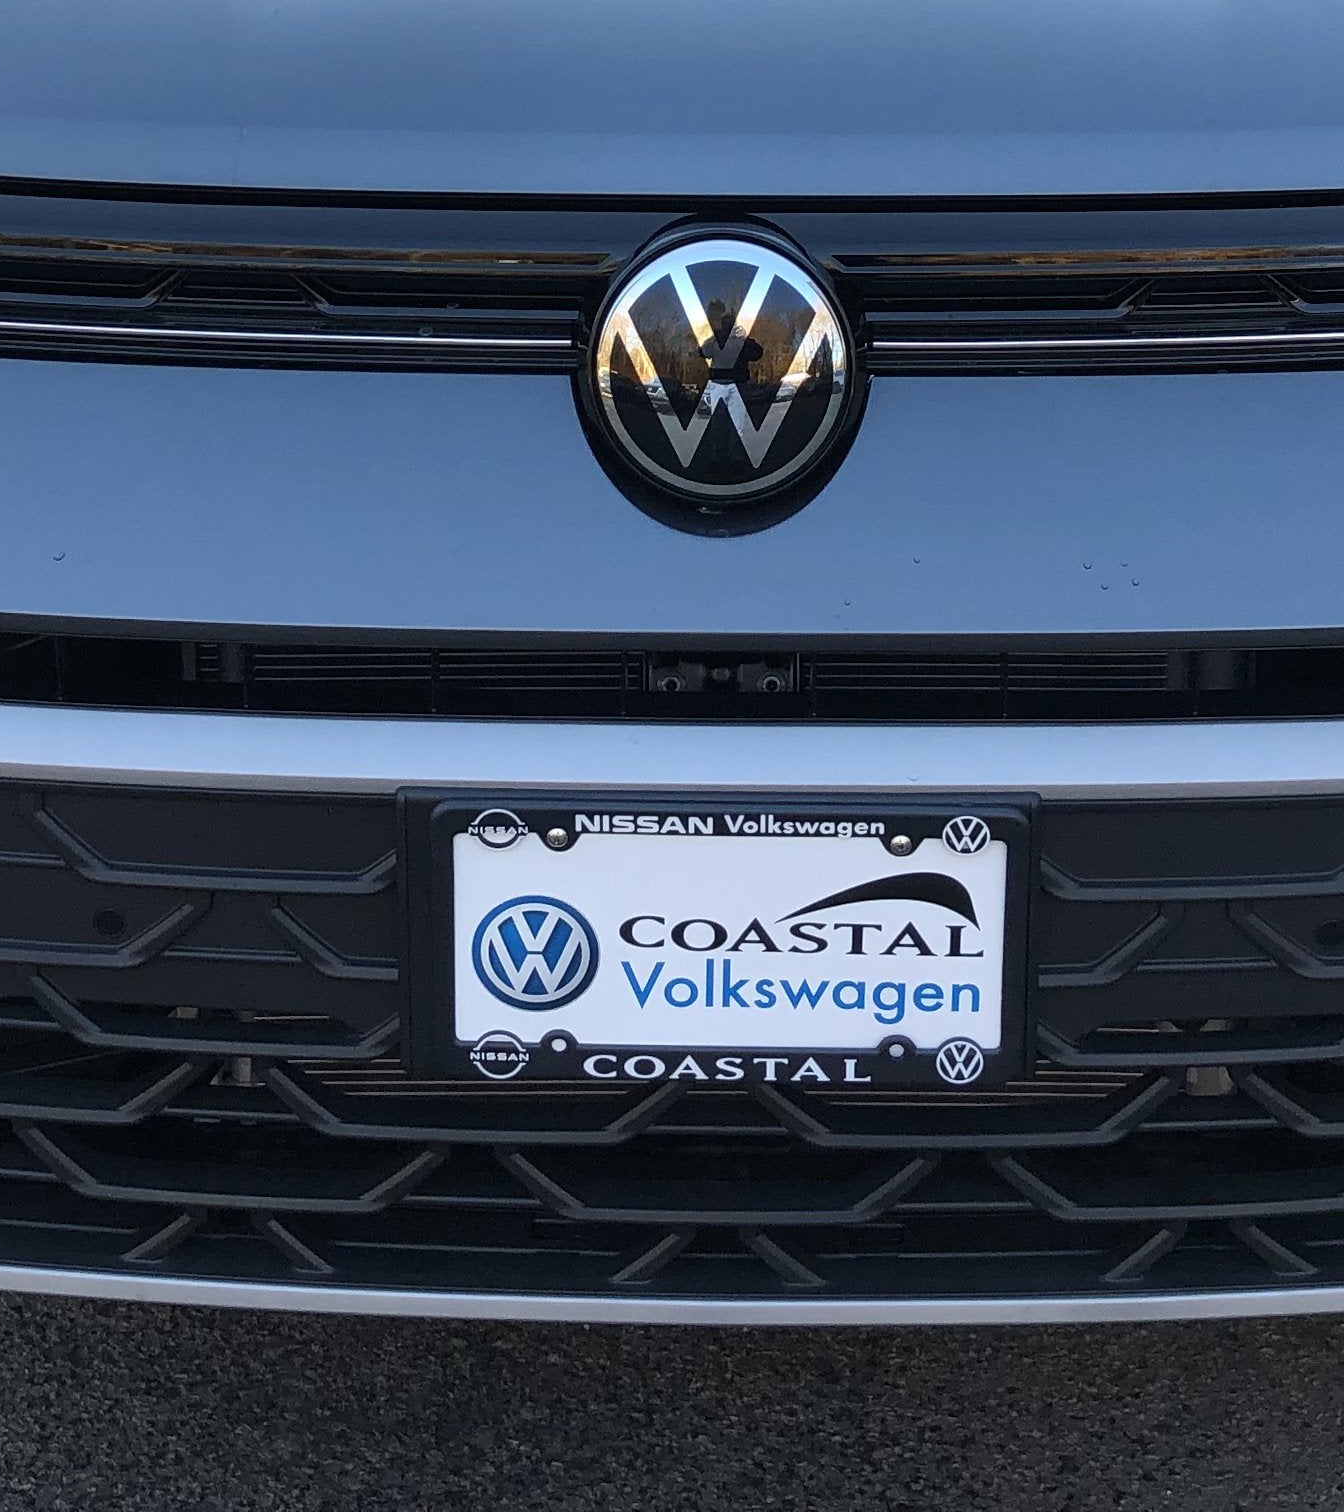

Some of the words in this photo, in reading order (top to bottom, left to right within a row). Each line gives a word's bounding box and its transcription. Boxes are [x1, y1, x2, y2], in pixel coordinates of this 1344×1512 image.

[467, 824, 529, 836] NISSAN
[574, 813, 715, 836] NISSAN
[723, 814, 886, 840] Volkswagen
[619, 915, 984, 959] COASTAL
[621, 958, 981, 1025] Volkswagen
[470, 1049, 530, 1064] NISSAN
[583, 1054, 873, 1082] COASTAL
